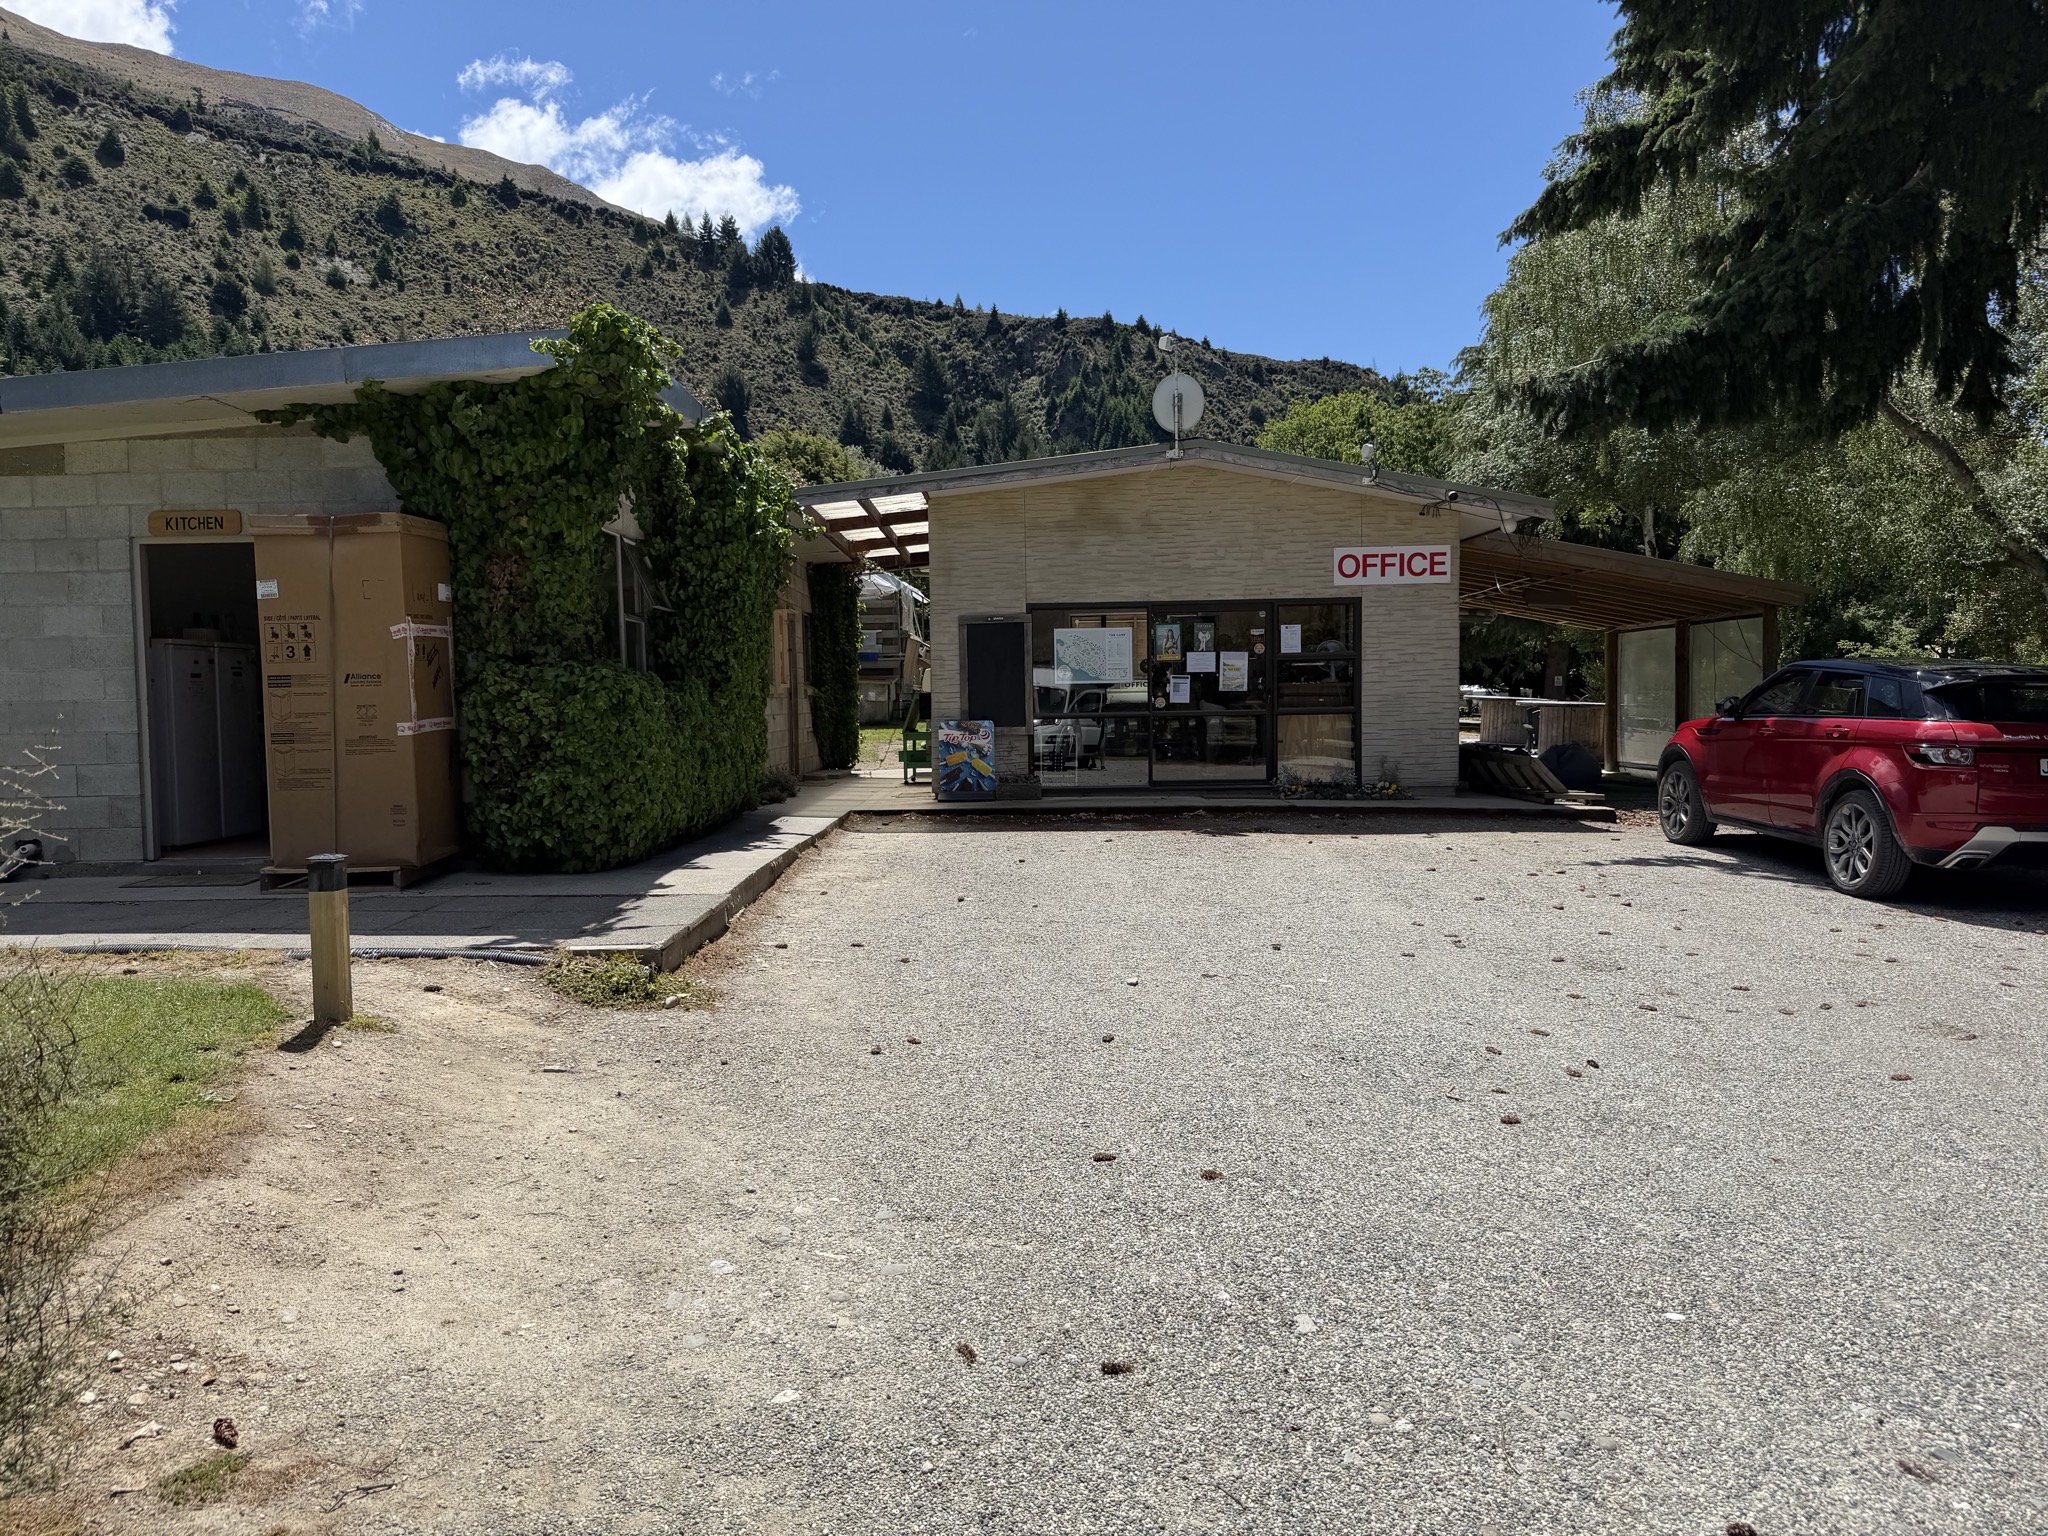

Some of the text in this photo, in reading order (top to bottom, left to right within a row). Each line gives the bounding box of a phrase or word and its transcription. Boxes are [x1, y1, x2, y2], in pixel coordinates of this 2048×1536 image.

[165, 516, 224, 531] KITCHEN
[1338, 552, 1447, 578] OFFICE
[286, 646, 295, 658] 3
[943, 733, 977, 745] Tip Top
